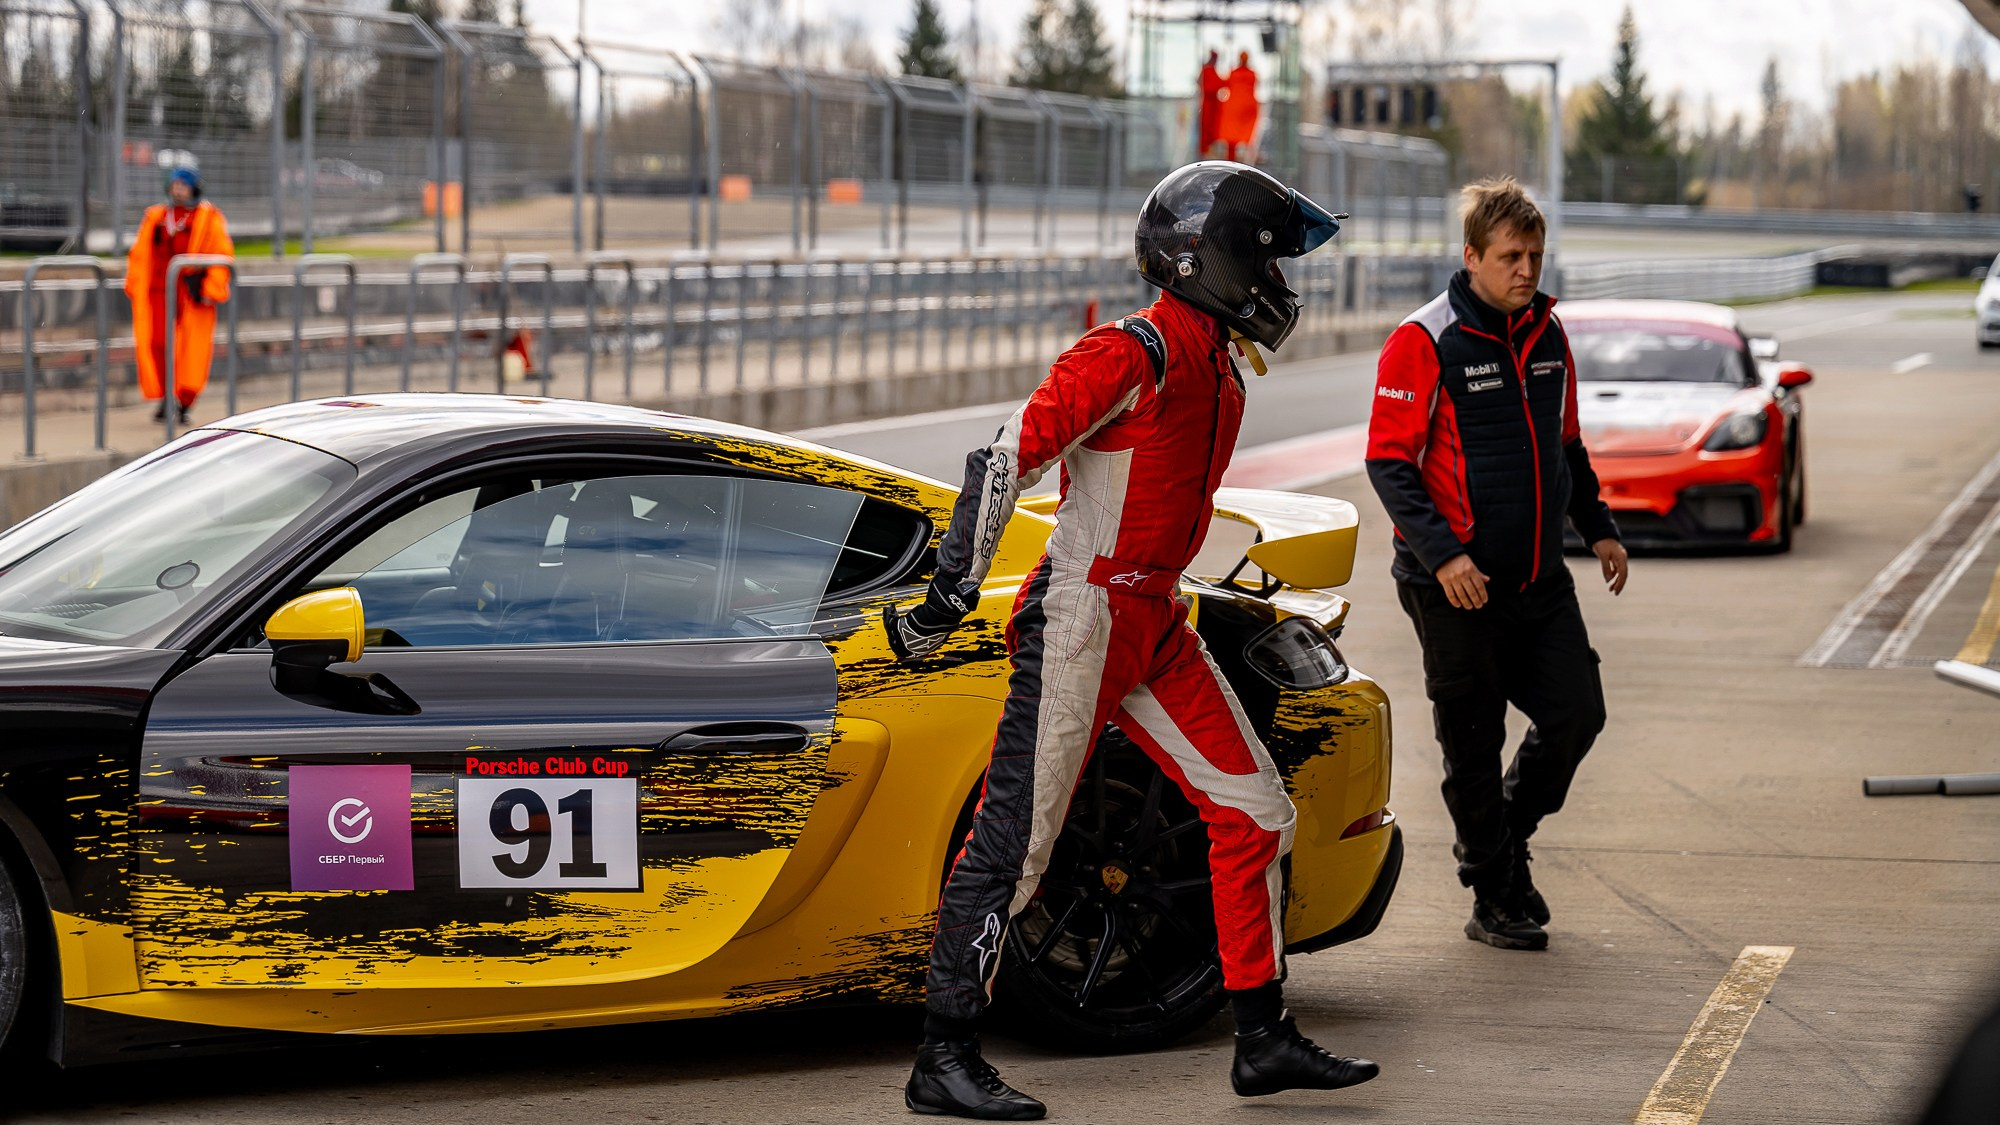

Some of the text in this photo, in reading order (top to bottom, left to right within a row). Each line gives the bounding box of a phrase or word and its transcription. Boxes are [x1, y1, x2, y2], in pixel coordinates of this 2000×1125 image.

[1464, 364, 1490, 378] Mobil
[1377, 386, 1404, 400] Mobil
[466, 757, 629, 777] Porsche Club Cup
[489, 787, 607, 879] 91
[318, 854, 385, 865] СБЕР Первый
